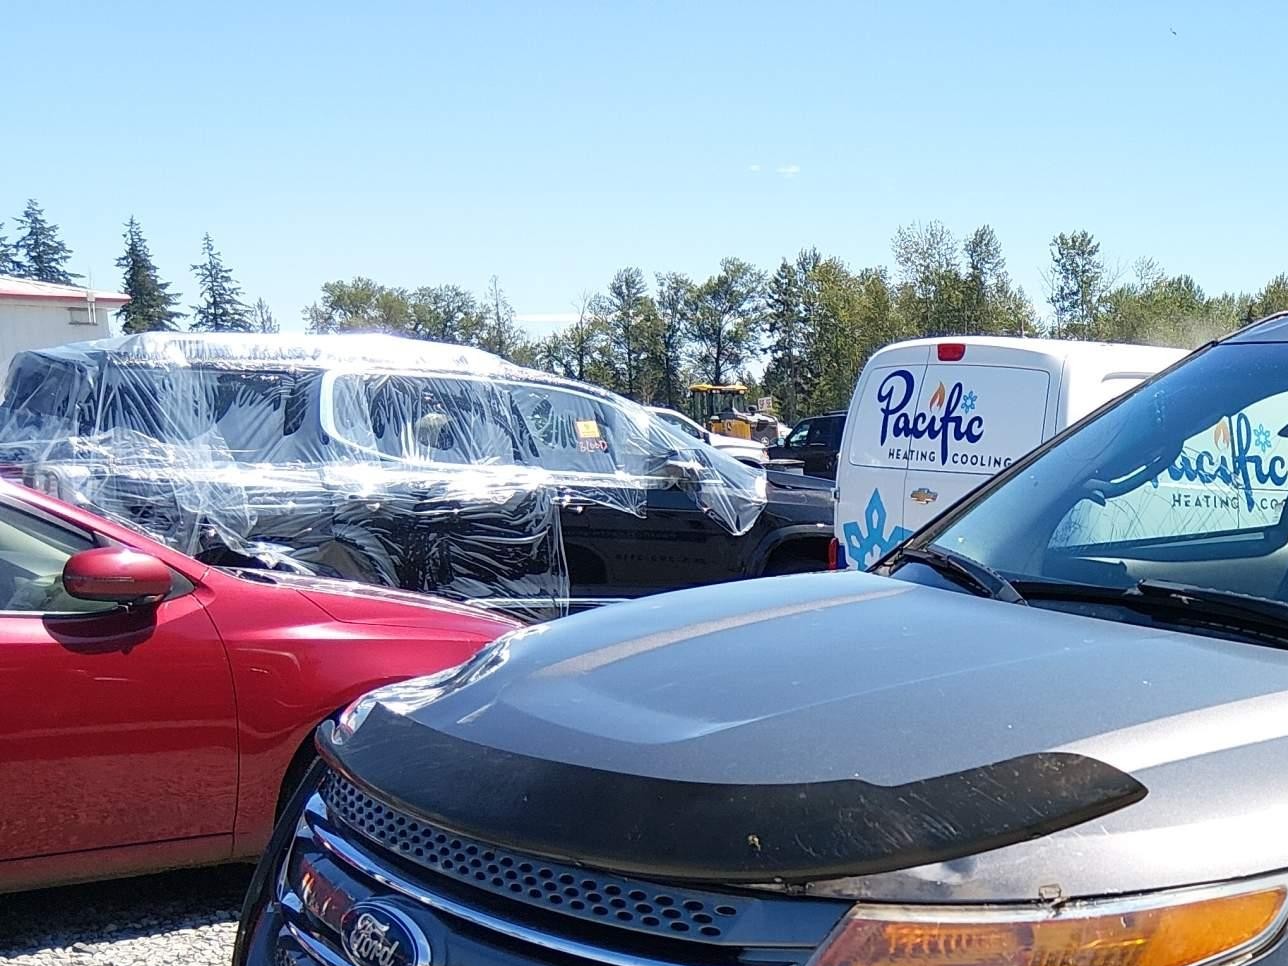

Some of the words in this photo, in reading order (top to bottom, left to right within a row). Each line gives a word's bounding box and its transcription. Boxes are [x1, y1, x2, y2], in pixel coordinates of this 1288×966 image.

[877, 369, 984, 466] Pacific
[888, 448, 936, 462] HEATING
[951, 452, 1013, 468] COOLING
[1152, 413, 1288, 513] acific
[1171, 493, 1240, 510] HEATING
